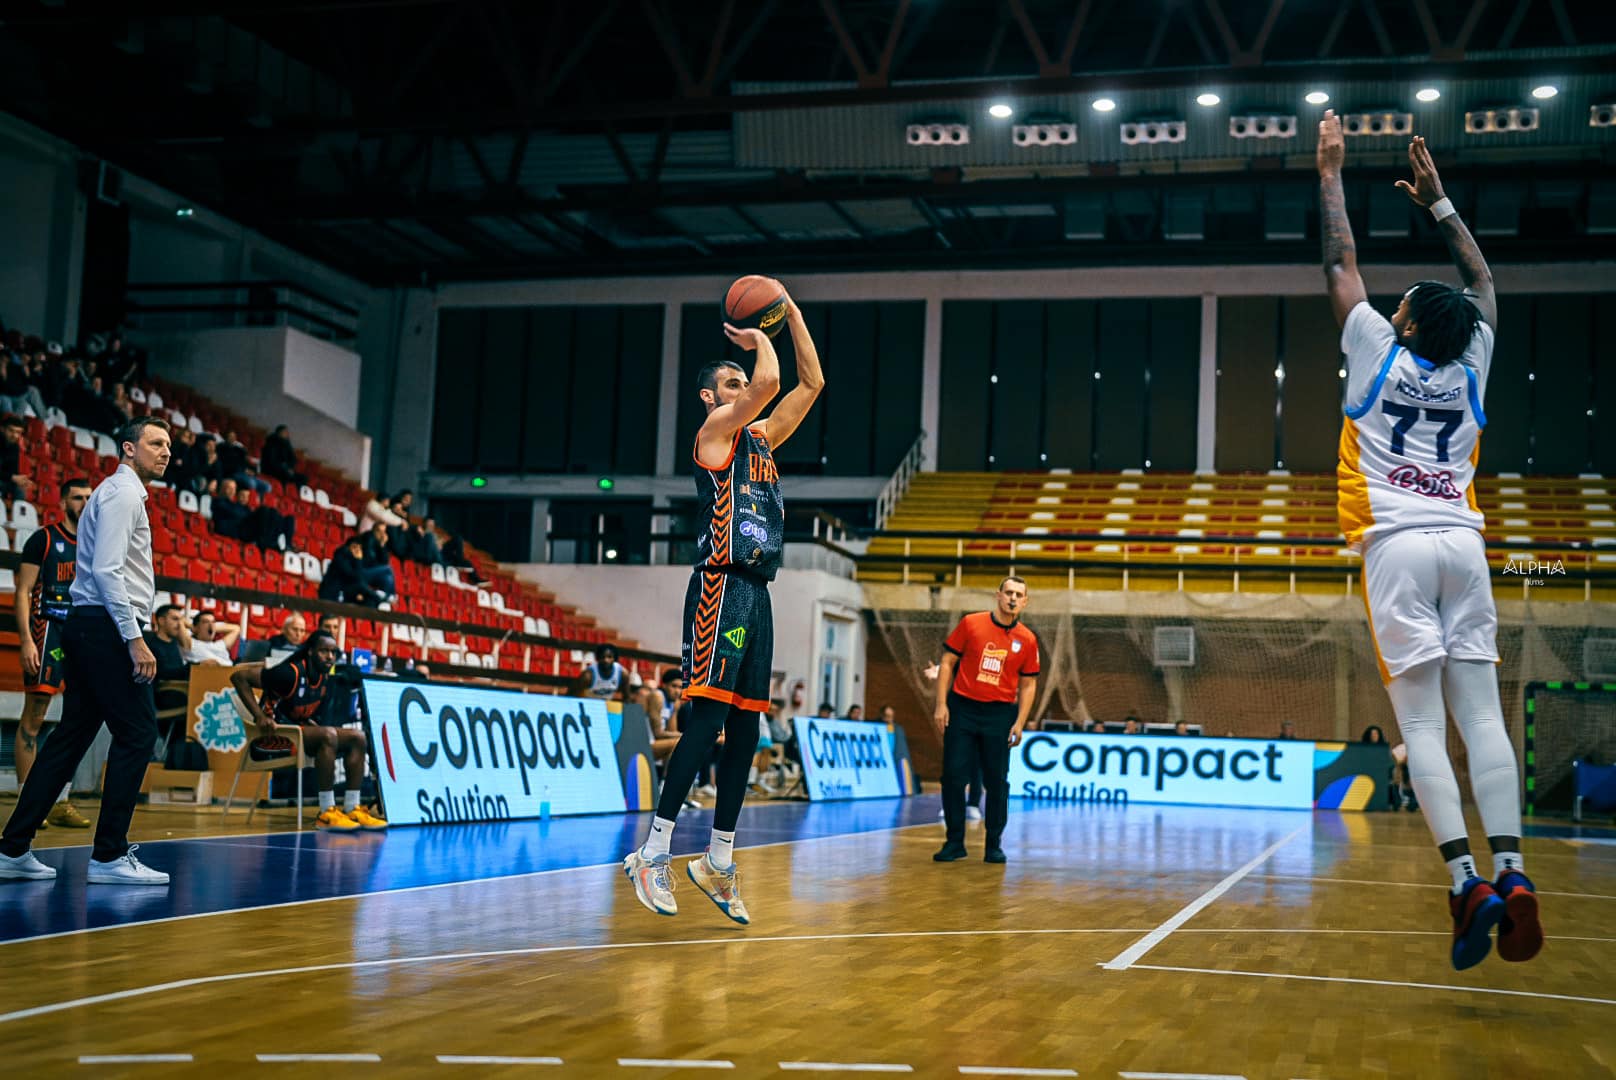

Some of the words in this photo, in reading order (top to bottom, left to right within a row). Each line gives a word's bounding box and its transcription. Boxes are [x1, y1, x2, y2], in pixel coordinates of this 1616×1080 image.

[1381, 398, 1465, 463] 77
[398, 686, 600, 796] Compact
[808, 720, 887, 784] Compact
[1021, 734, 1283, 791] Compact
[417, 784, 510, 825] Solution
[1022, 781, 1128, 803] Solution
